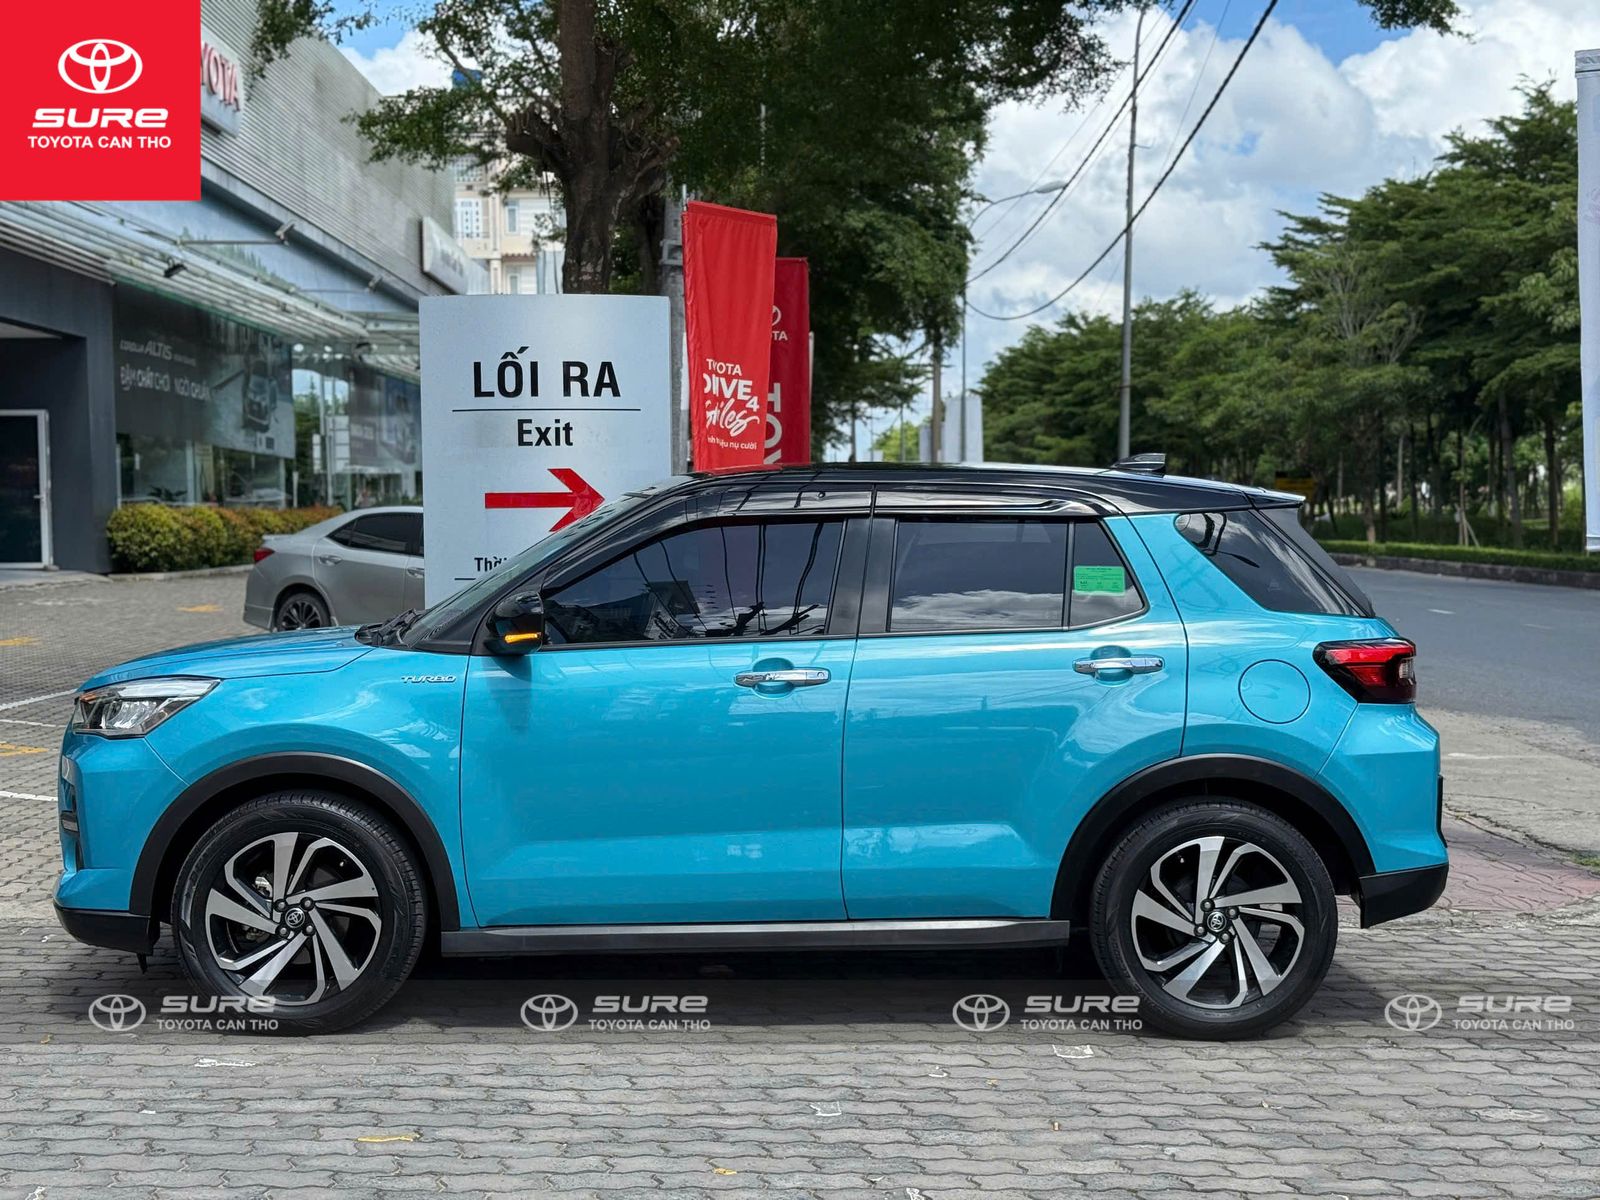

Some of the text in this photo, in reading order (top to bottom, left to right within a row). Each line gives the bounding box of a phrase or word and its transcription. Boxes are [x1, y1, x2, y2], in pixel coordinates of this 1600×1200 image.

[144, 340, 173, 361] ALTIS
[473, 346, 622, 398] LỐI RA
[745, 396, 760, 412] 4
[517, 418, 574, 447] Exit
[474, 556, 507, 572] Thờ
[401, 675, 457, 684] TURBO
